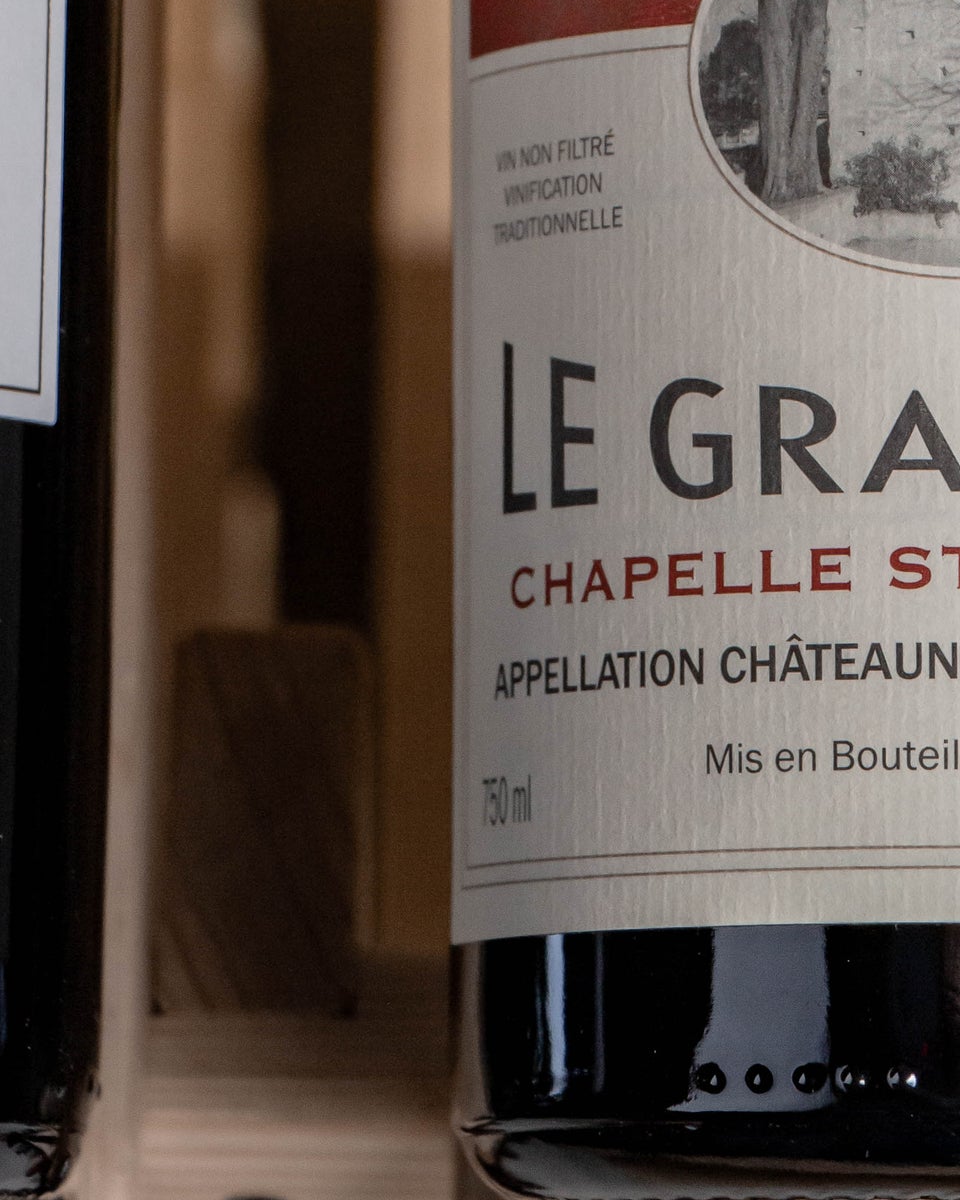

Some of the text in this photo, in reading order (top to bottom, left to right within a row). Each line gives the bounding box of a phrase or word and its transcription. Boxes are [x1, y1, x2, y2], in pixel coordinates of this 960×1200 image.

[519, 143, 551, 167] NON
[557, 129, 615, 162] FILTRÉ
[504, 171, 603, 207] VINIFICATION
[494, 205, 624, 245] TRADITIONNELLE
[502, 340, 600, 516] LE
[510, 545, 852, 611] CHAPELLE
[494, 646, 704, 701] APPELLATION
[705, 742, 764, 775] Mis
[775, 745, 818, 773] en
[512, 773, 532, 823] ml
